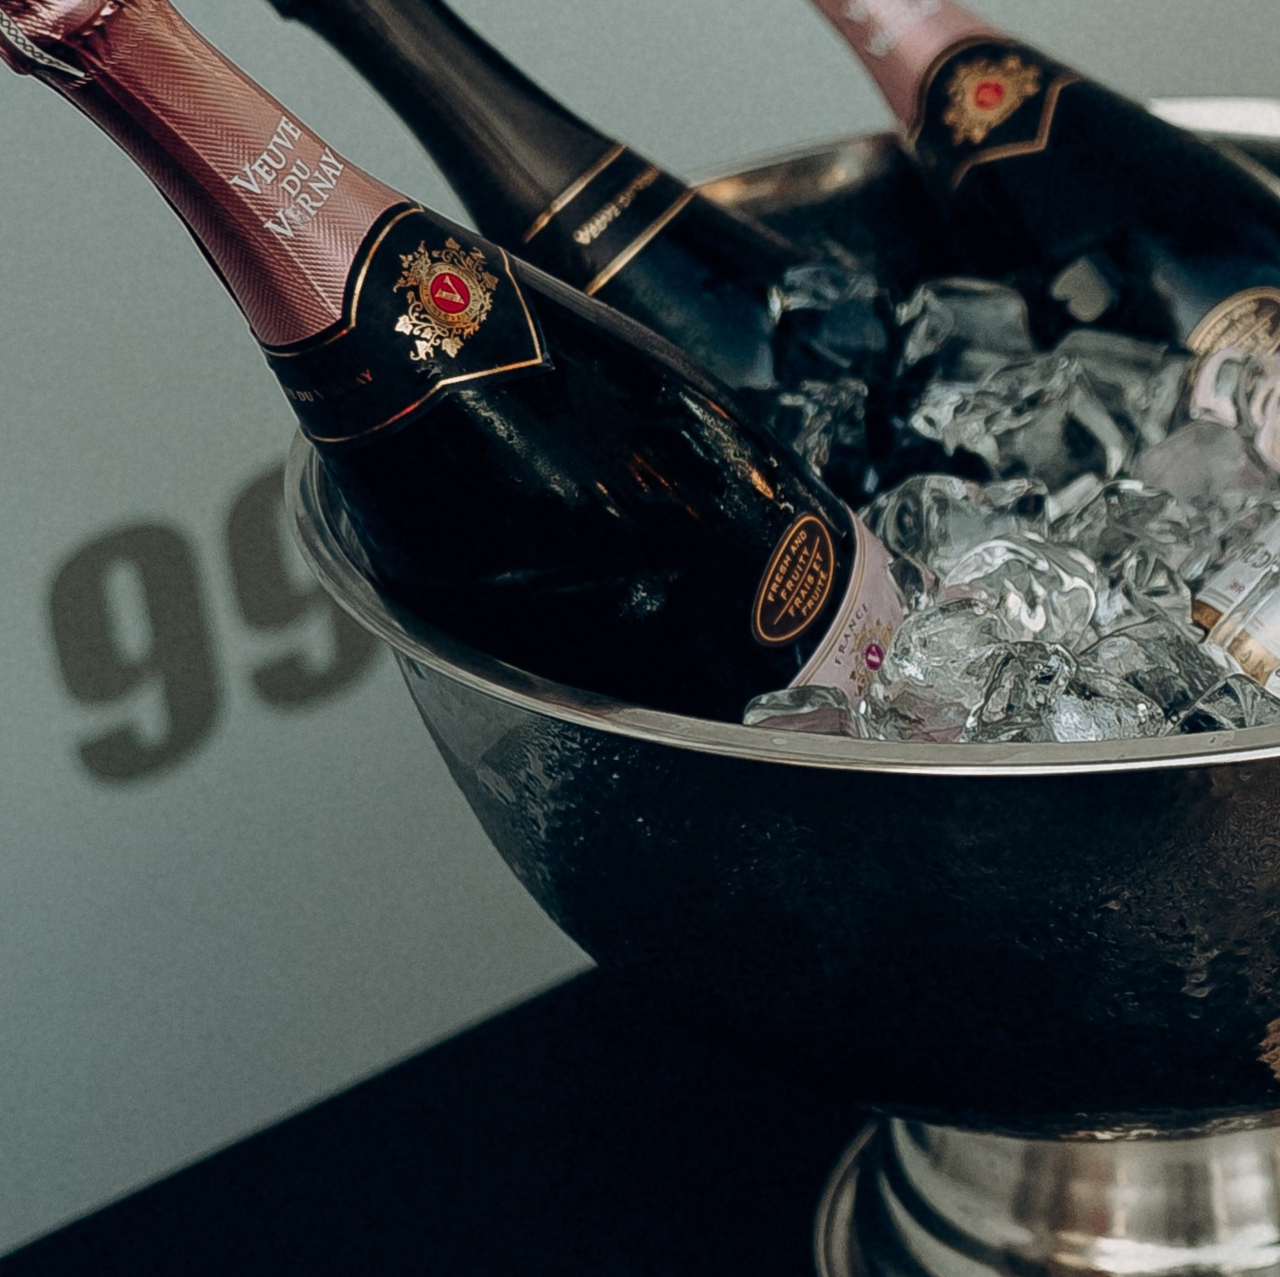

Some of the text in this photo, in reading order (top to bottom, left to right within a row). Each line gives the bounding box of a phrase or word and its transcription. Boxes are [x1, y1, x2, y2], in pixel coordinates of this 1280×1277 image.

[230, 116, 302, 194] VEUVE
[280, 159, 310, 197] DU
[263, 147, 344, 237] VERNAY
[767, 530, 807, 602] FRESH AND
[780, 546, 810, 600] FRUITY
[788, 552, 823, 617] FRAIS ET
